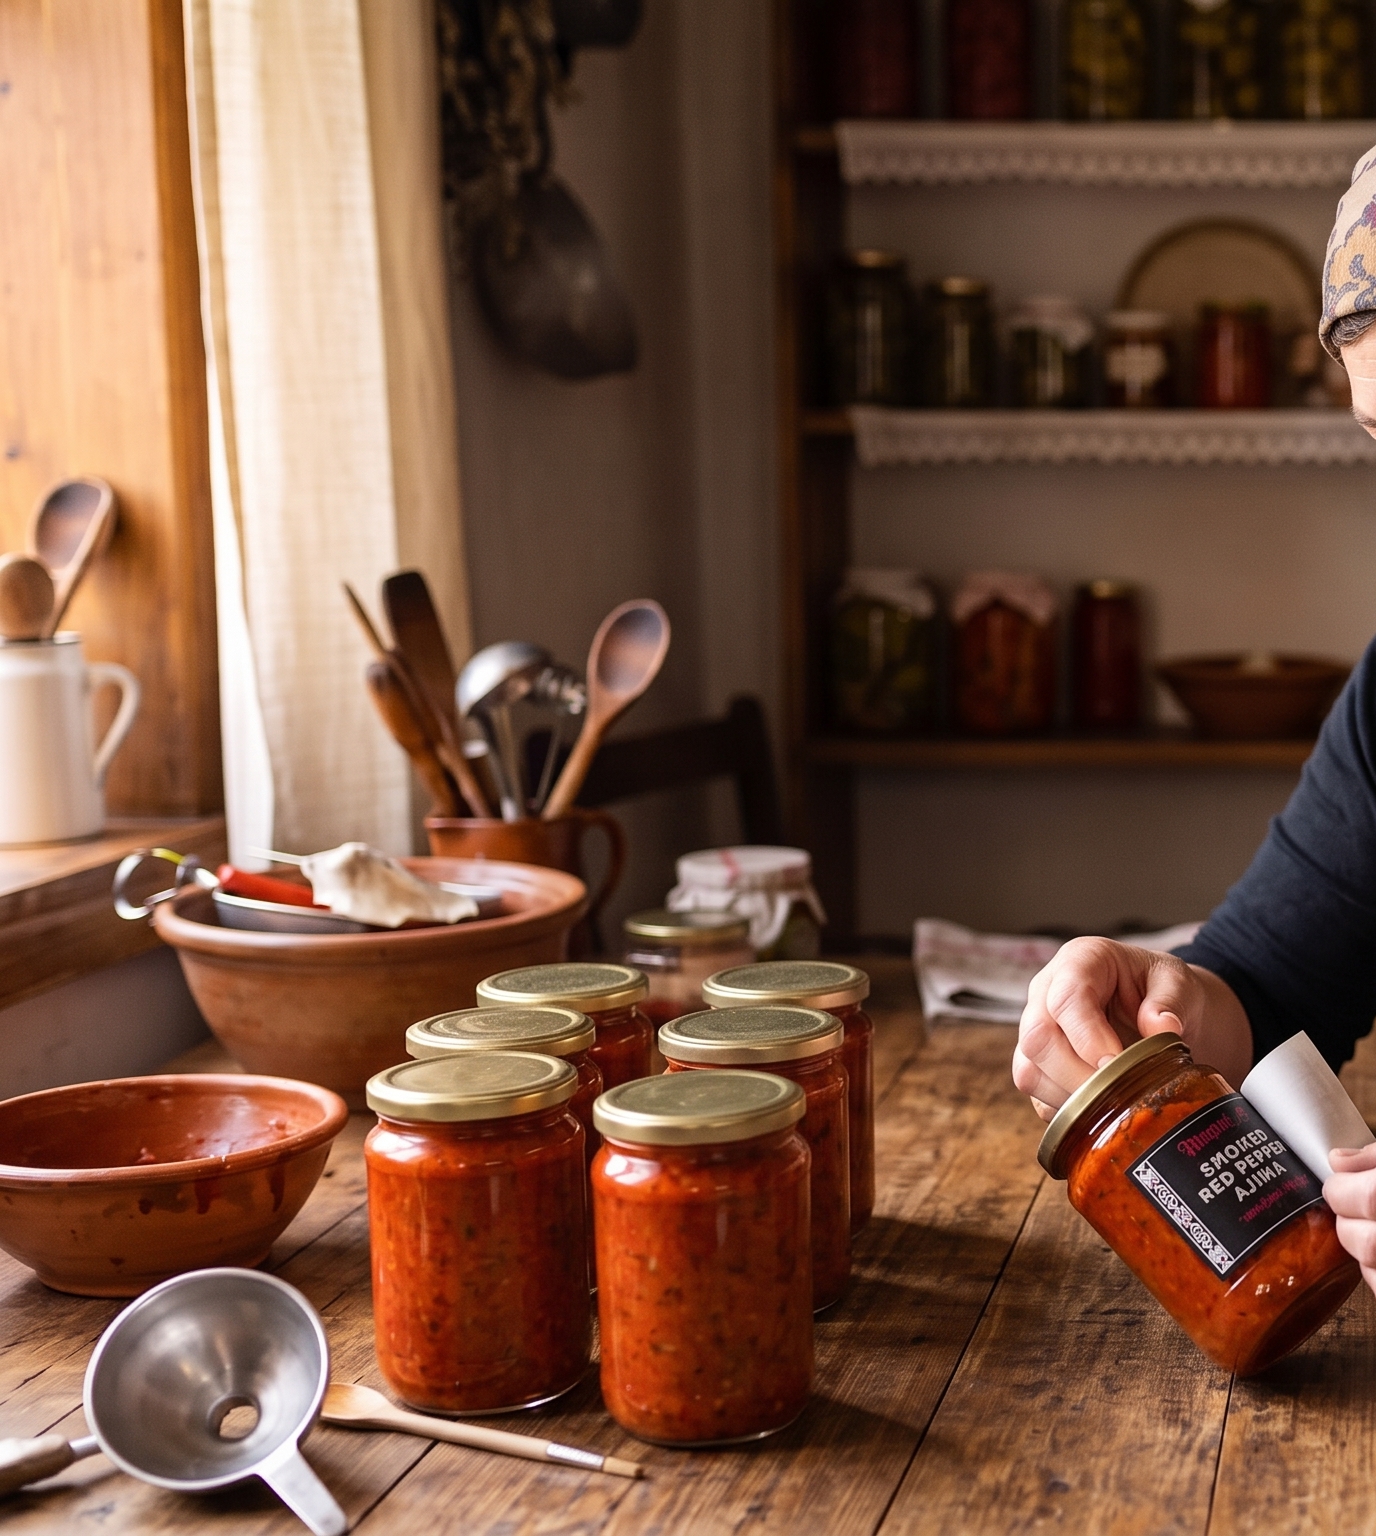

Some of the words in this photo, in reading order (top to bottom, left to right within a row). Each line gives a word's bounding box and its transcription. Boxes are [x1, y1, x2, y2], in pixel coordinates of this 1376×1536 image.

[1198, 1171, 1235, 1204] RED
[1234, 1140, 1288, 1175] PEPPER
[1200, 1128, 1268, 1178] SMOKED
